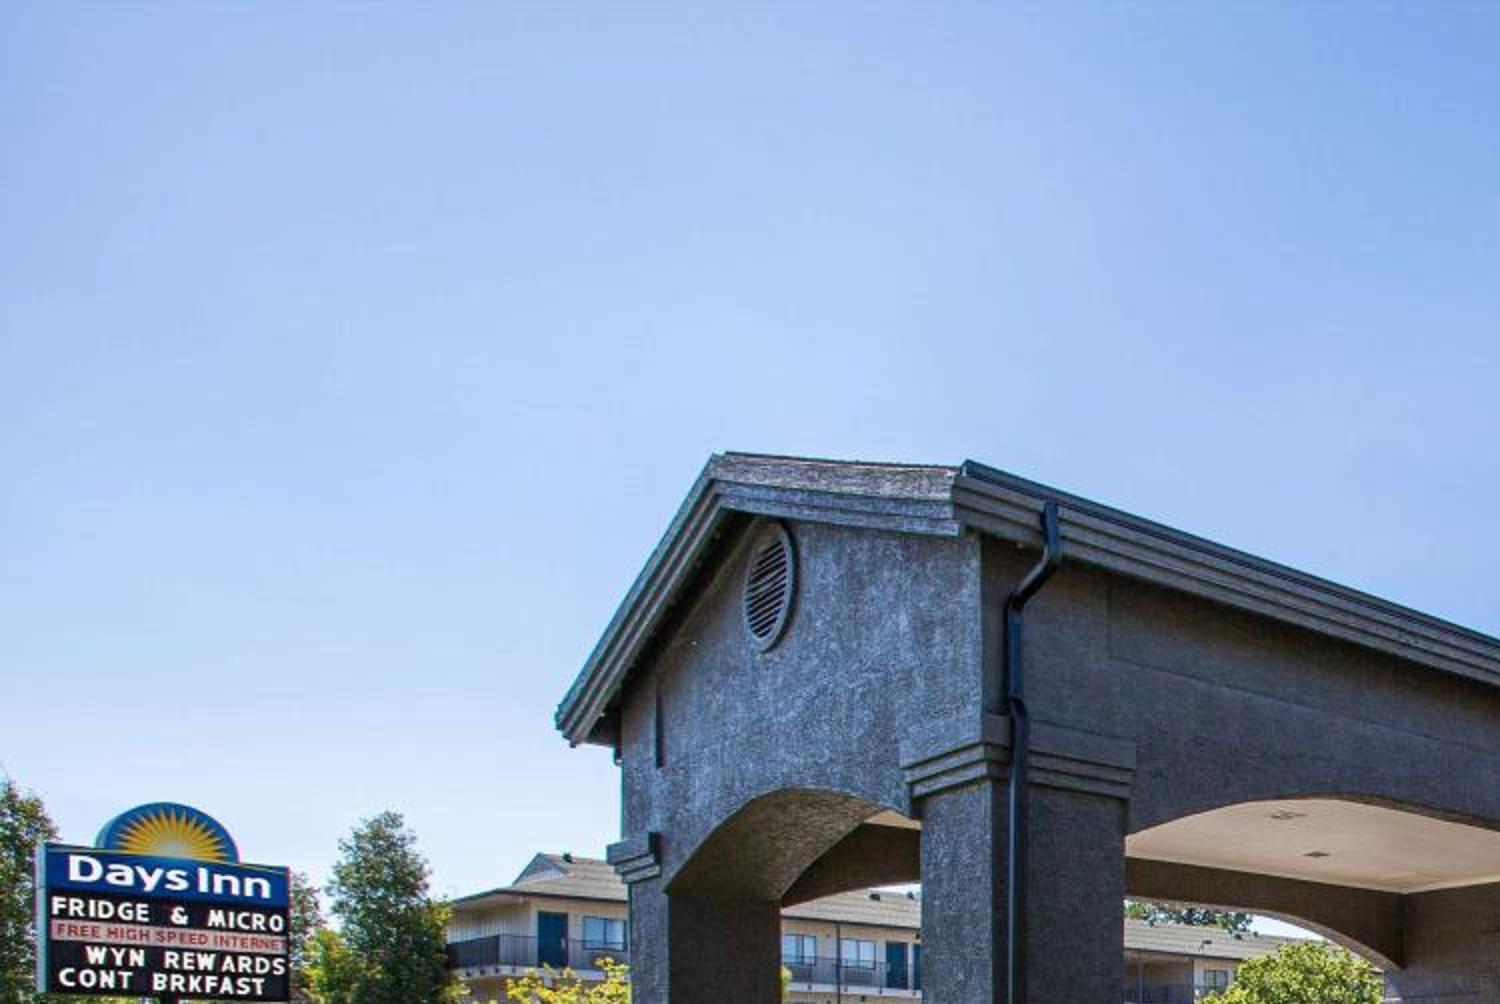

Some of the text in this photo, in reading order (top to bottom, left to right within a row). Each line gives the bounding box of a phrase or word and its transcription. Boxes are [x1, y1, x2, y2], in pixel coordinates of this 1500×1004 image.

[68, 854, 272, 899] Days Inn
[51, 895, 284, 933] FRIDGE & MICRO
[57, 923, 101, 939] FREE
[106, 926, 151, 943] HIGH
[156, 930, 209, 946] SPEED
[85, 945, 286, 976] WYN REWARDS
[59, 967, 265, 996] CONT BRKFAST
